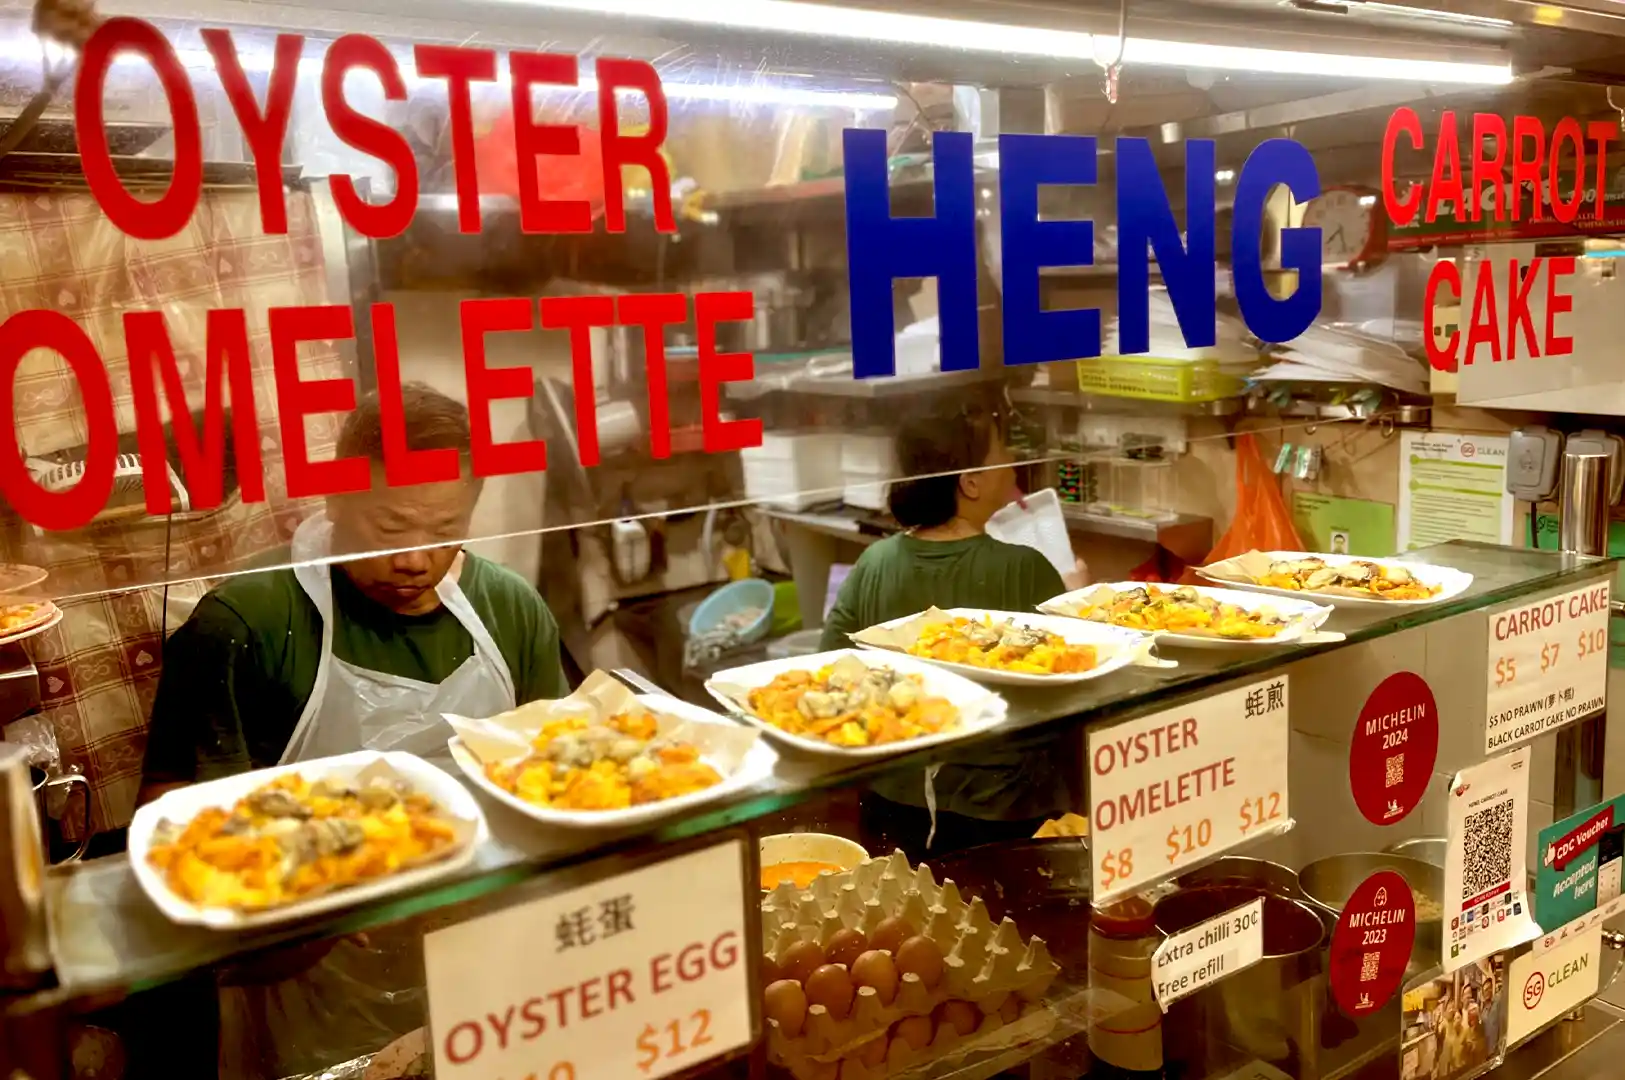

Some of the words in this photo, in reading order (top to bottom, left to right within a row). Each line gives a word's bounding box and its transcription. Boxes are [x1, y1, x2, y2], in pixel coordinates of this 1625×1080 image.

[75, 17, 677, 239] OYSTER
[1382, 106, 1618, 226] CARROT
[843, 128, 1321, 380] HENG
[1424, 257, 1576, 371] CAKE
[0, 291, 763, 530] OMELETTE
[1477, 447, 1506, 456] CLEAN
[1495, 600, 1565, 641] CARROT
[1569, 587, 1609, 619] CAKE
[1495, 656, 1517, 688] $5
[1540, 641, 1561, 674] $7
[1577, 628, 1606, 661] $10
[1244, 680, 1285, 719] 蚝煎
[1366, 702, 1427, 737] MICHELIN
[1488, 730, 1513, 749] BLACK
[1514, 718, 1545, 739] CARROT
[1546, 711, 1565, 727] CAKE
[1565, 706, 1577, 719] NO
[1578, 696, 1605, 715] PRAWN
[1489, 714, 1499, 729] $5
[1500, 710, 1513, 724] NO
[1514, 698, 1544, 718] PRAWN
[1093, 717, 1199, 777] OYSTER
[1382, 728, 1409, 750] 2024
[1095, 757, 1236, 832] OMELETTE
[1101, 847, 1133, 891] $8
[1166, 818, 1212, 865] $10
[1239, 791, 1281, 835] $12
[1557, 838, 1575, 860] CDC
[1576, 816, 1609, 846] Voucher
[1553, 855, 1596, 898] Accepted
[1574, 876, 1595, 900] here
[554, 894, 637, 952] 蚝蛋
[1158, 941, 1194, 968] Extra
[1198, 921, 1230, 950] chilli
[1234, 910, 1259, 934] 30¢
[1349, 908, 1406, 928] MICHELIN
[1362, 929, 1387, 946] 2023
[443, 968, 636, 1065] OYSTER
[649, 930, 739, 996] EGG
[1158, 975, 1188, 996] Free
[1193, 954, 1224, 983] refill
[1547, 953, 1589, 989] CLEAN
[635, 1008, 713, 1073] $12
